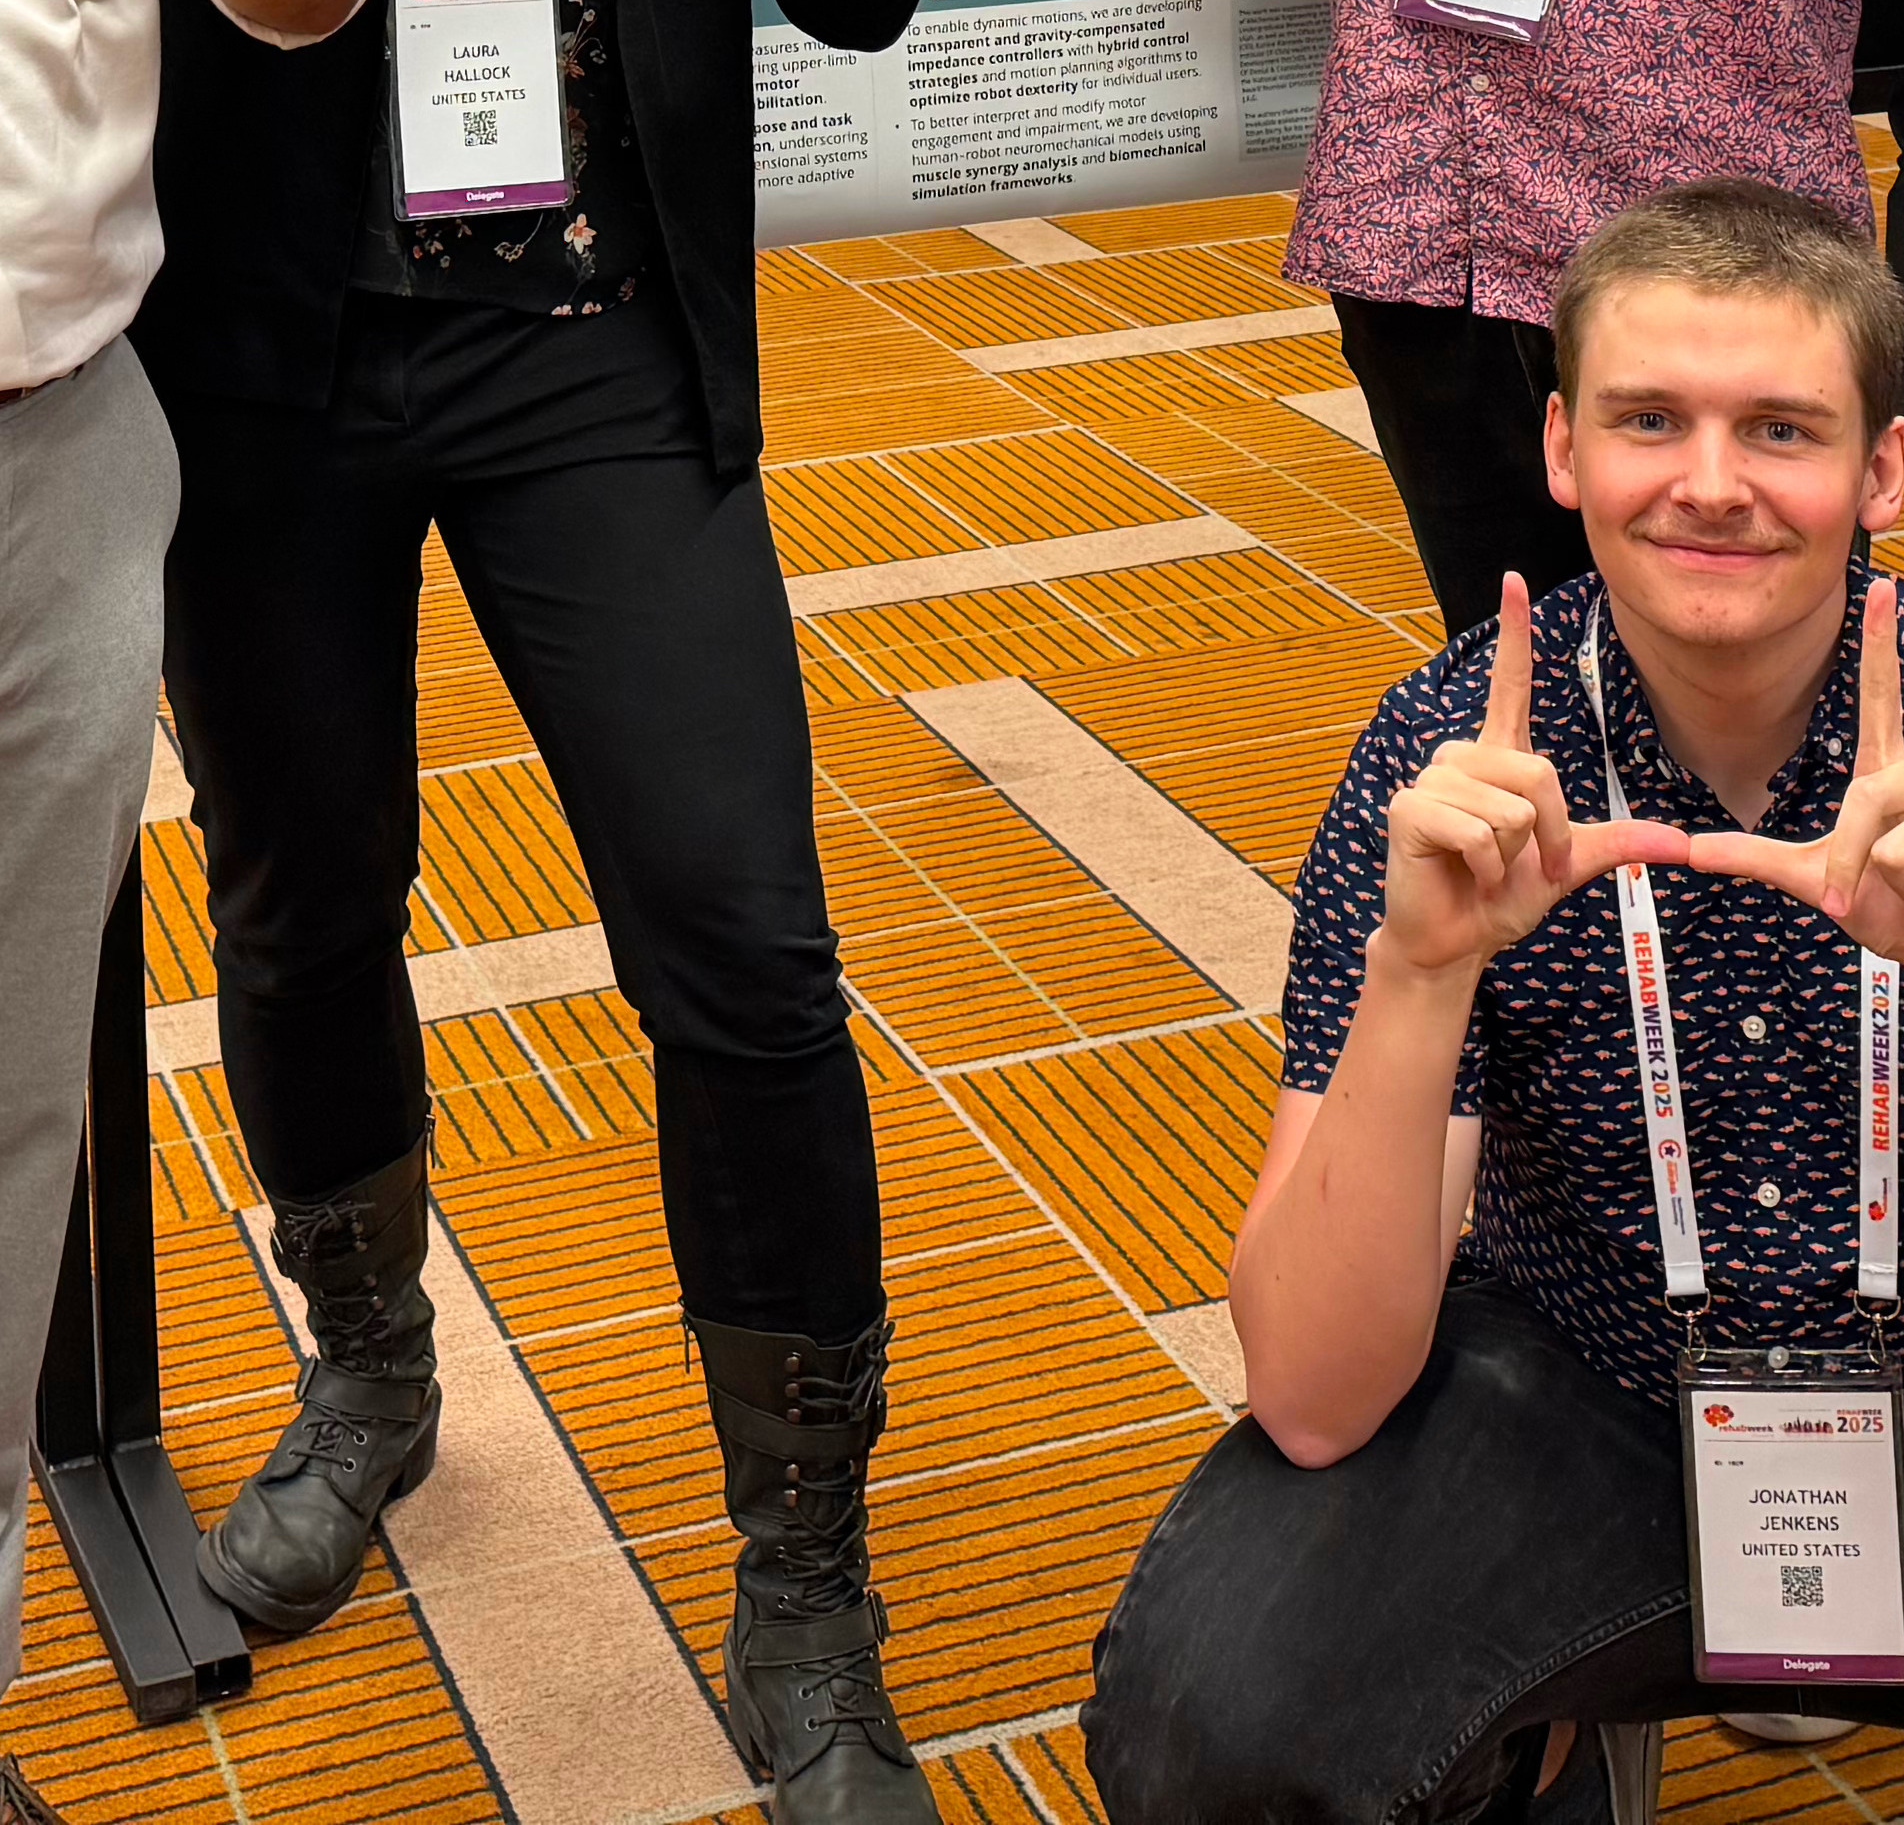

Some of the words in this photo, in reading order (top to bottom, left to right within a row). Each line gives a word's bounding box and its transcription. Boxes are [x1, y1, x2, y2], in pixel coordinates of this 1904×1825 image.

[453, 45, 500, 59] LAURA
[444, 66, 511, 83] HALLOCK
[432, 92, 476, 105] UNITED
[481, 88, 525, 102] STATES
[912, 168, 961, 183] muscle
[965, 163, 1018, 180] synergy
[1022, 154, 1077, 173] analysis
[1082, 151, 1105, 165] and
[1109, 139, 1205, 162] biomechanical
[1632, 931, 1666, 1064] REHABWEEK
[1651, 1069, 1673, 1118] 2025
[1837, 1416, 1884, 1433] 2025
[1749, 1489, 1848, 1505] JONATHAN
[1760, 1516, 1840, 1531] JENKENS
[1742, 1543, 1798, 1556] UNITED
[1803, 1543, 1860, 1557] STATES
[1783, 1659, 1831, 1672] Delegate
